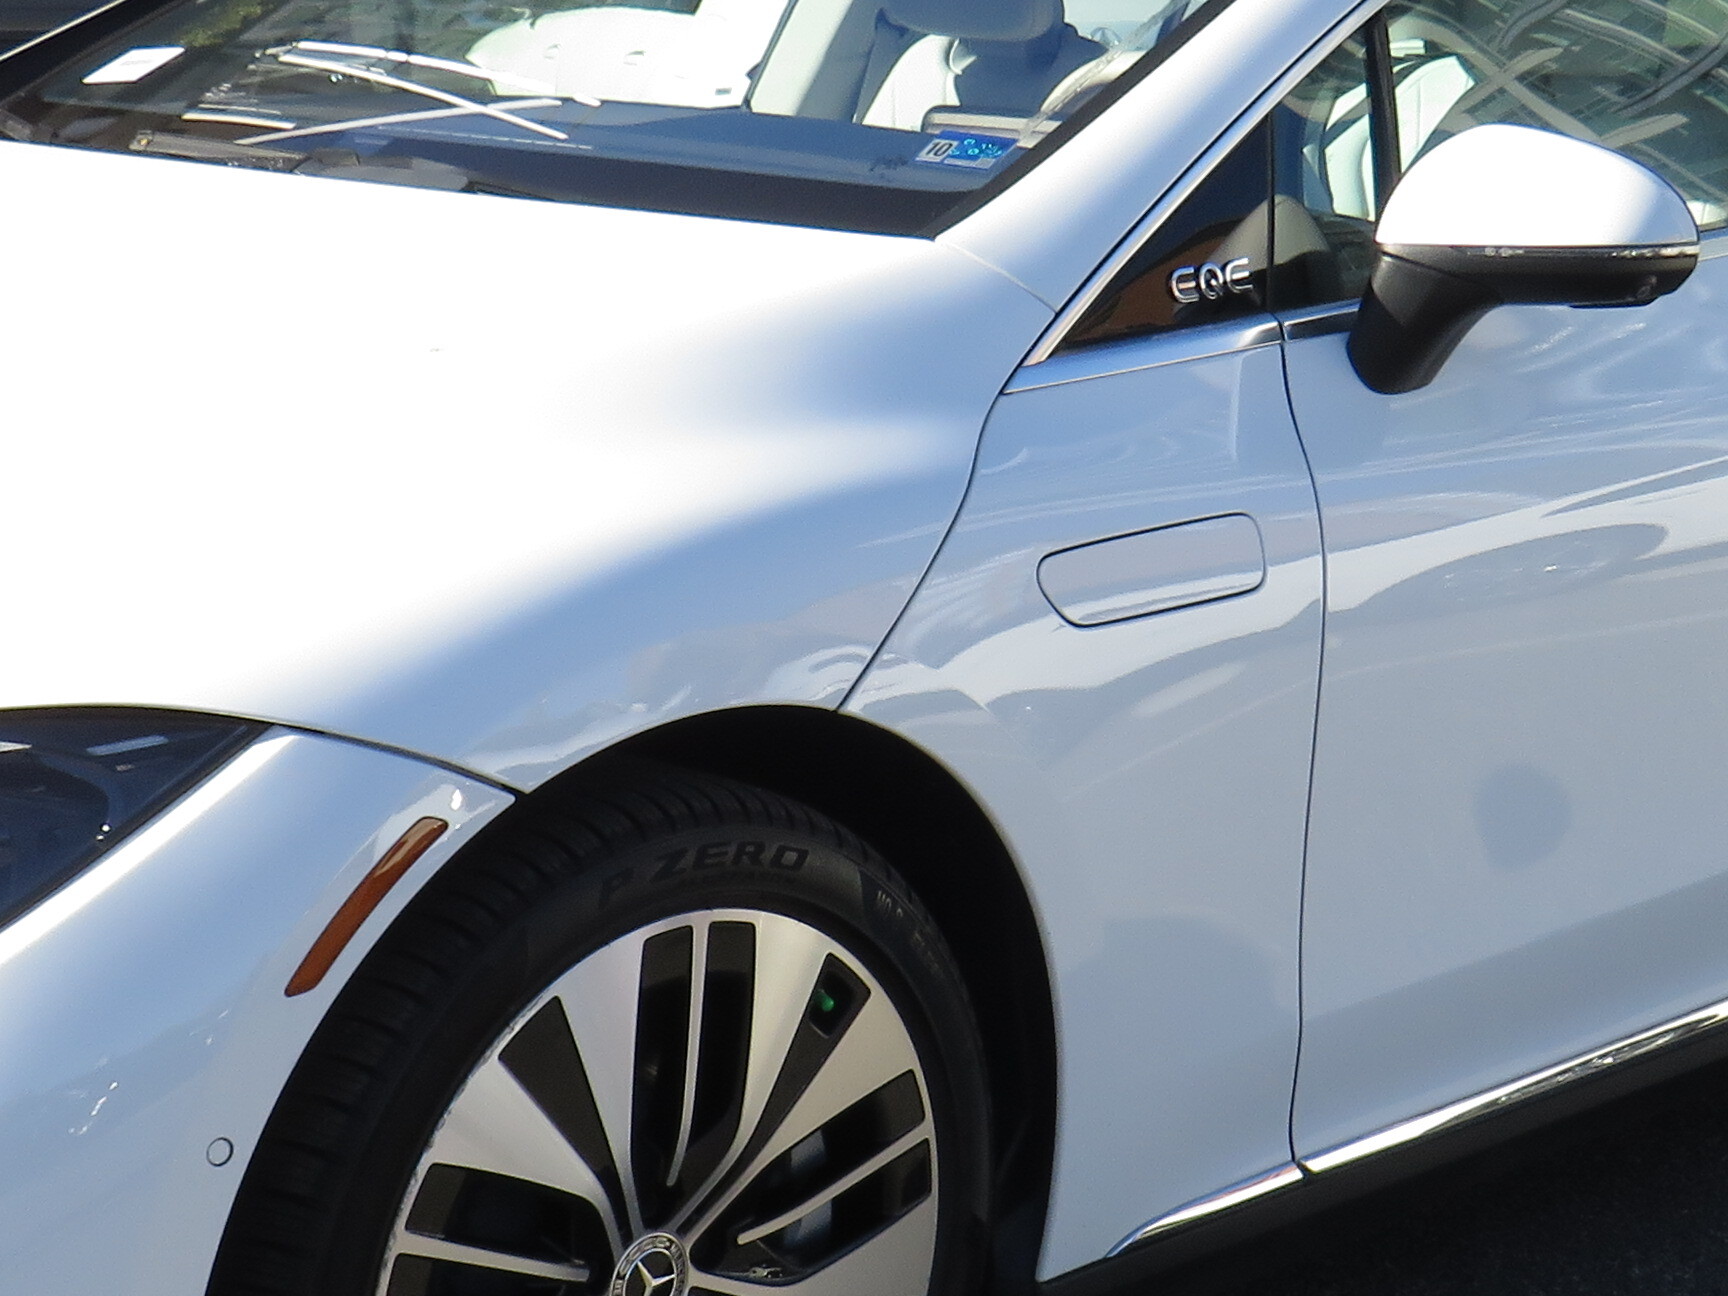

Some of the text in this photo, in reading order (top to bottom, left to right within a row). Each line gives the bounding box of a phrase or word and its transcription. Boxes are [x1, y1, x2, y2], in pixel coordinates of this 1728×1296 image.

[925, 141, 954, 157] 10
[1170, 256, 1254, 304] EQE
[650, 840, 810, 884] ZERO
